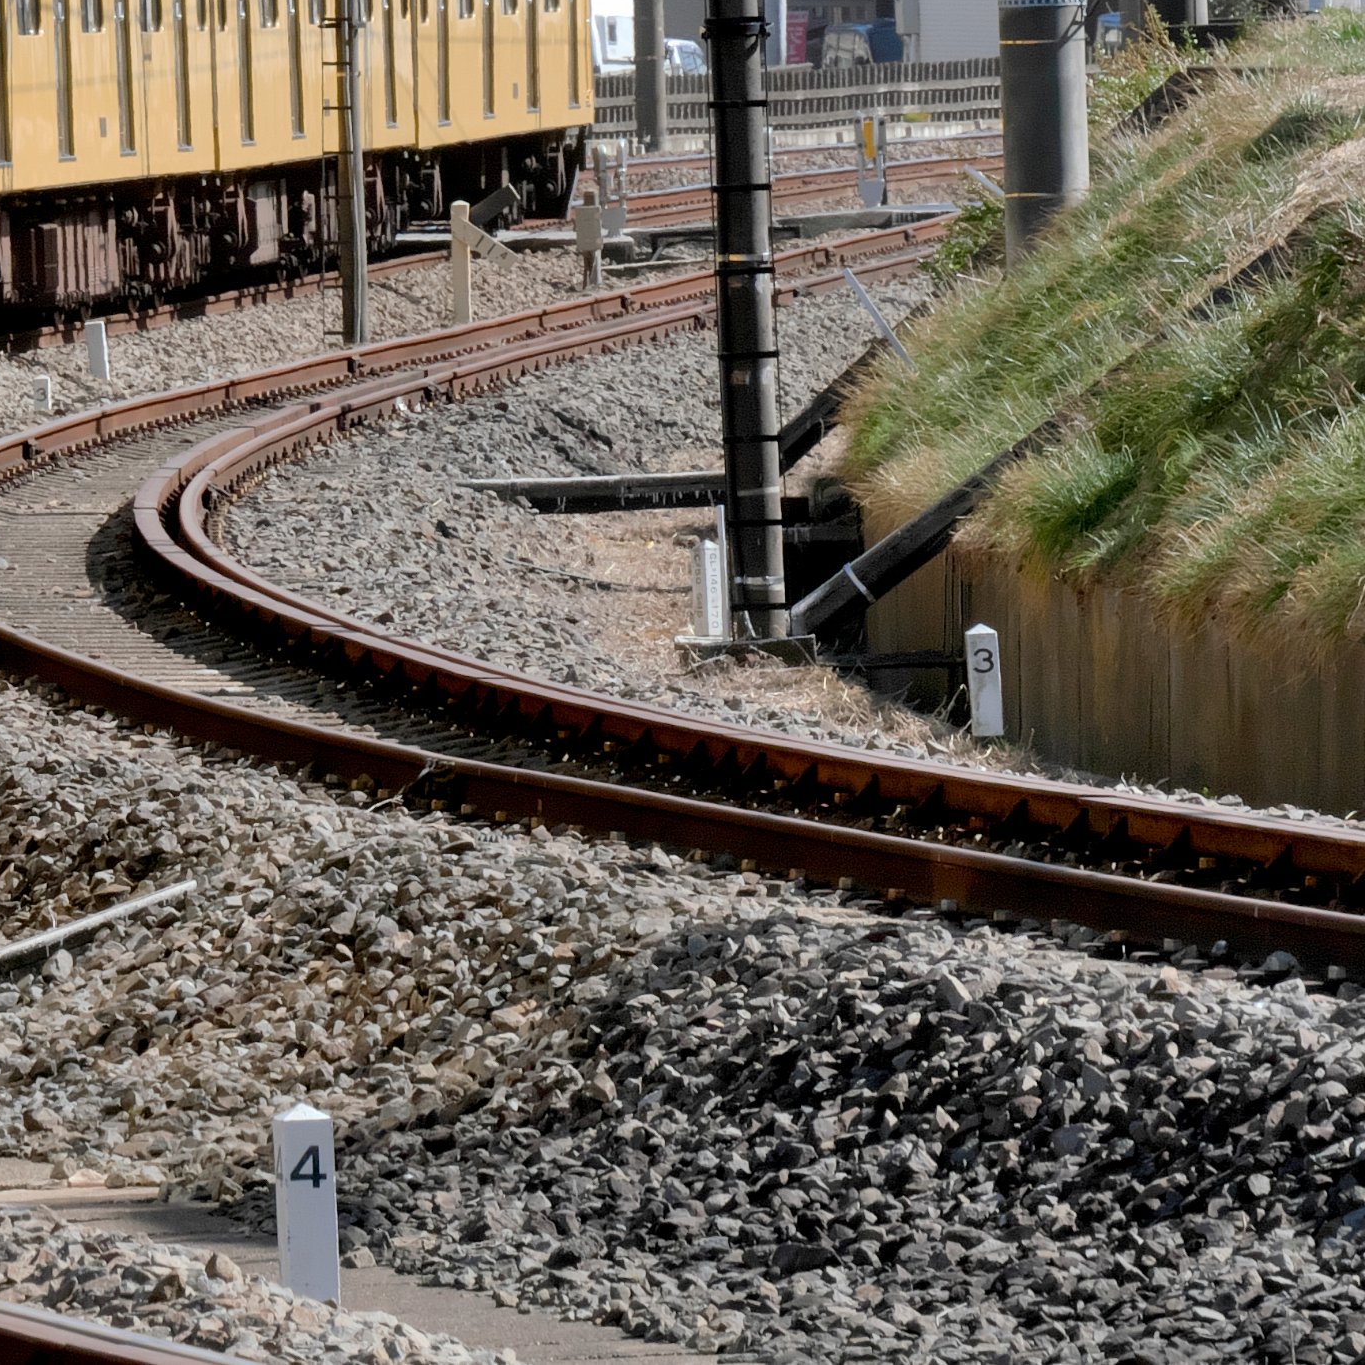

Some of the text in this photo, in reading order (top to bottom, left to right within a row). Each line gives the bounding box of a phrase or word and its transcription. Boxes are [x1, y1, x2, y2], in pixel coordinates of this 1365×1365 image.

[36, 387, 47, 402] 3
[973, 648, 994, 673] 3
[290, 1145, 327, 1188] 4
